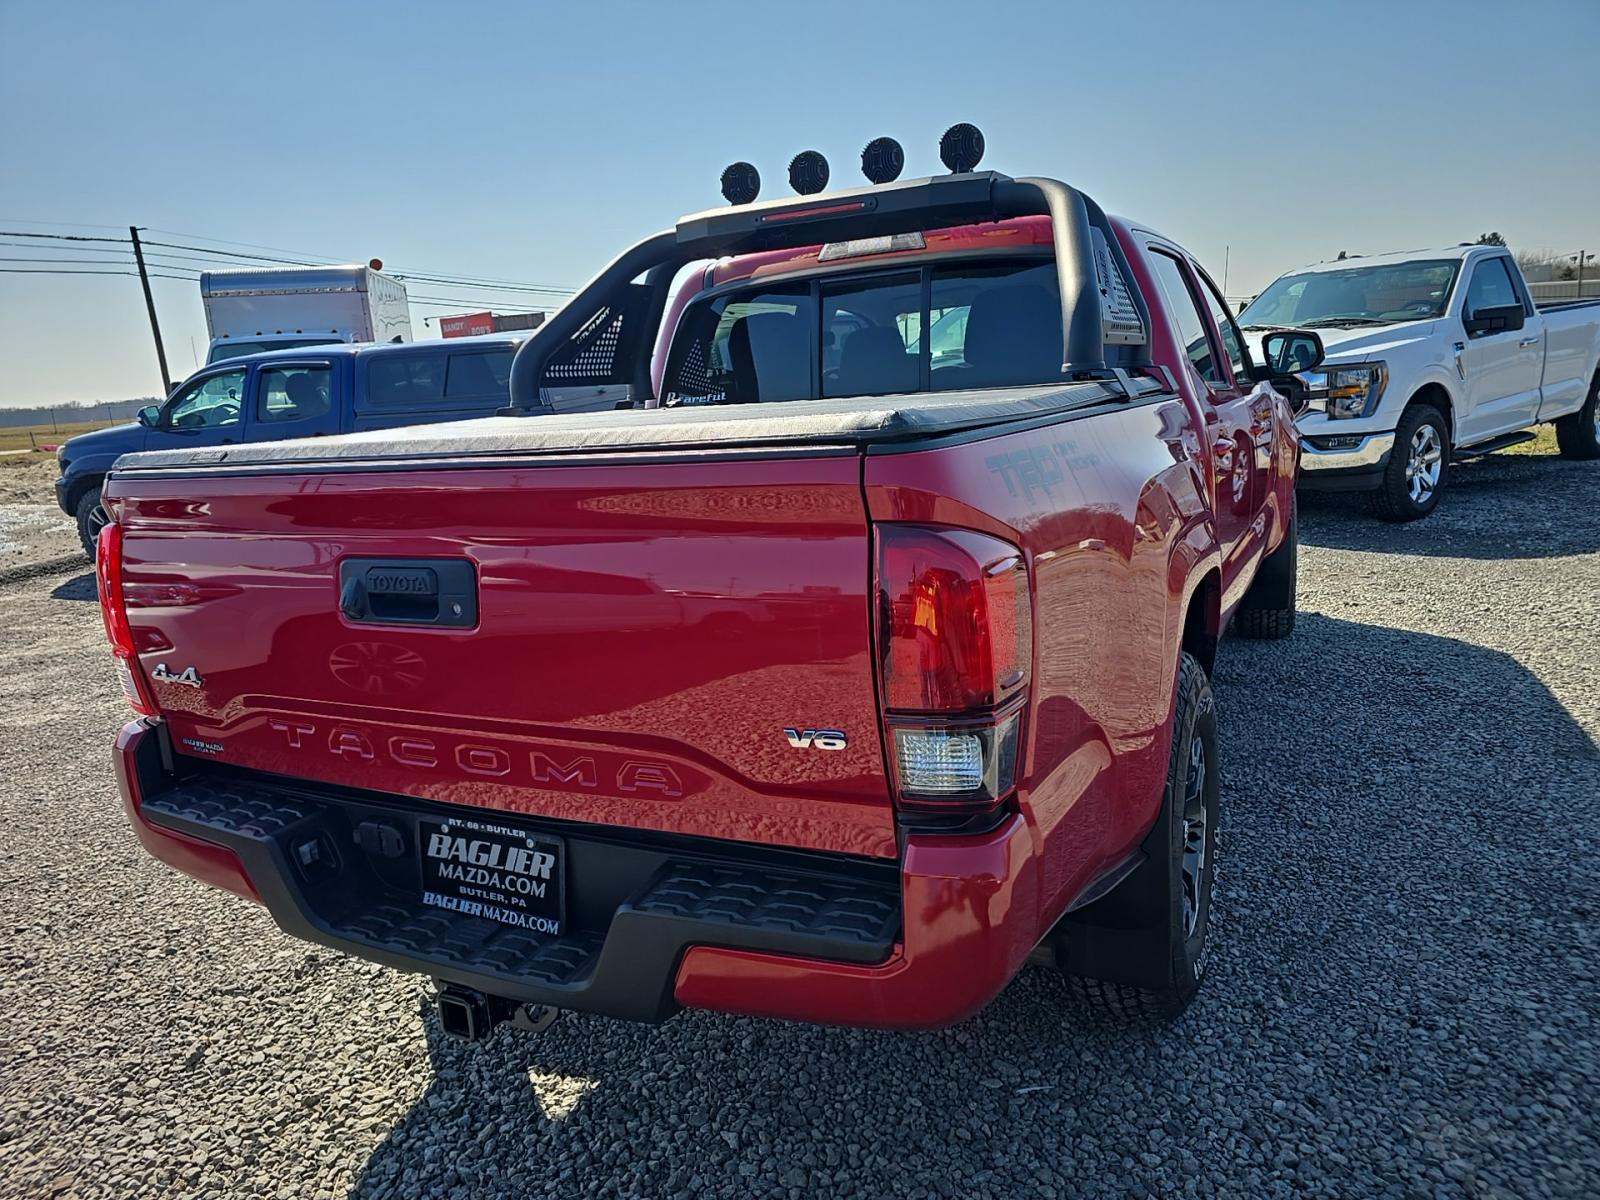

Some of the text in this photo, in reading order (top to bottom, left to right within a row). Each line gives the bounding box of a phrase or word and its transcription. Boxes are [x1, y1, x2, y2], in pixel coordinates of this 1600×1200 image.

[369, 575, 430, 592] TOYOTA
[783, 729, 847, 750] V6
[267, 717, 683, 797] TACOMA
[449, 818, 465, 828] RT.
[486, 824, 526, 838] BUTLER
[427, 833, 555, 880] BAGLIER
[438, 862, 547, 898] MAZDA.COM
[459, 886, 527, 907] BUTLER, PA
